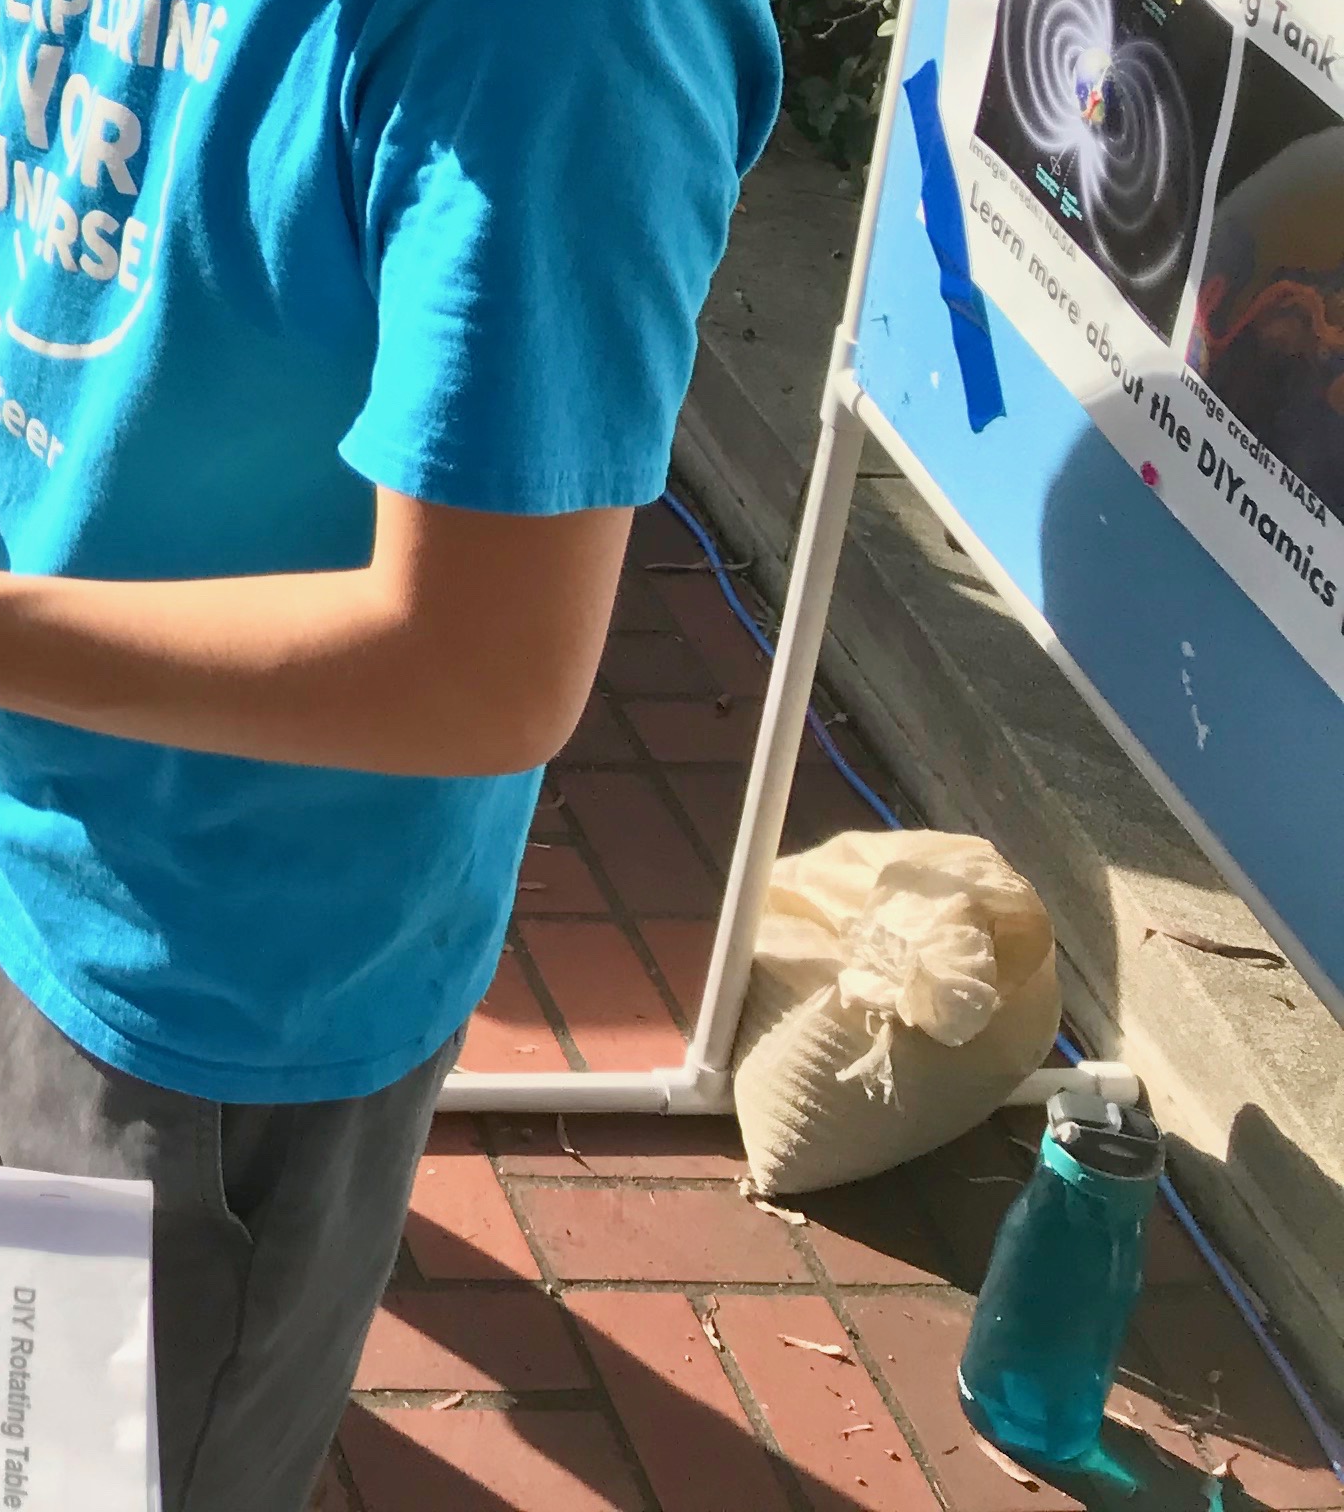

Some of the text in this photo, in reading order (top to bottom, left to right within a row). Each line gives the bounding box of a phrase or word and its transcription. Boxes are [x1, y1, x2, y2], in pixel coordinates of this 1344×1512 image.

[16, 31, 143, 197] YOR
[968, 135, 1009, 182] Image
[1043, 217, 1077, 263] NASA
[968, 179, 1026, 262] Learn
[1027, 252, 1083, 326] more
[1085, 320, 1144, 405] about
[1149, 391, 1192, 453] the
[1196, 438, 1338, 608] DIYnamics
[1179, 366, 1328, 528] Image credit: NASA
[0, 1284, 37, 1509] DIY Rotating Table
